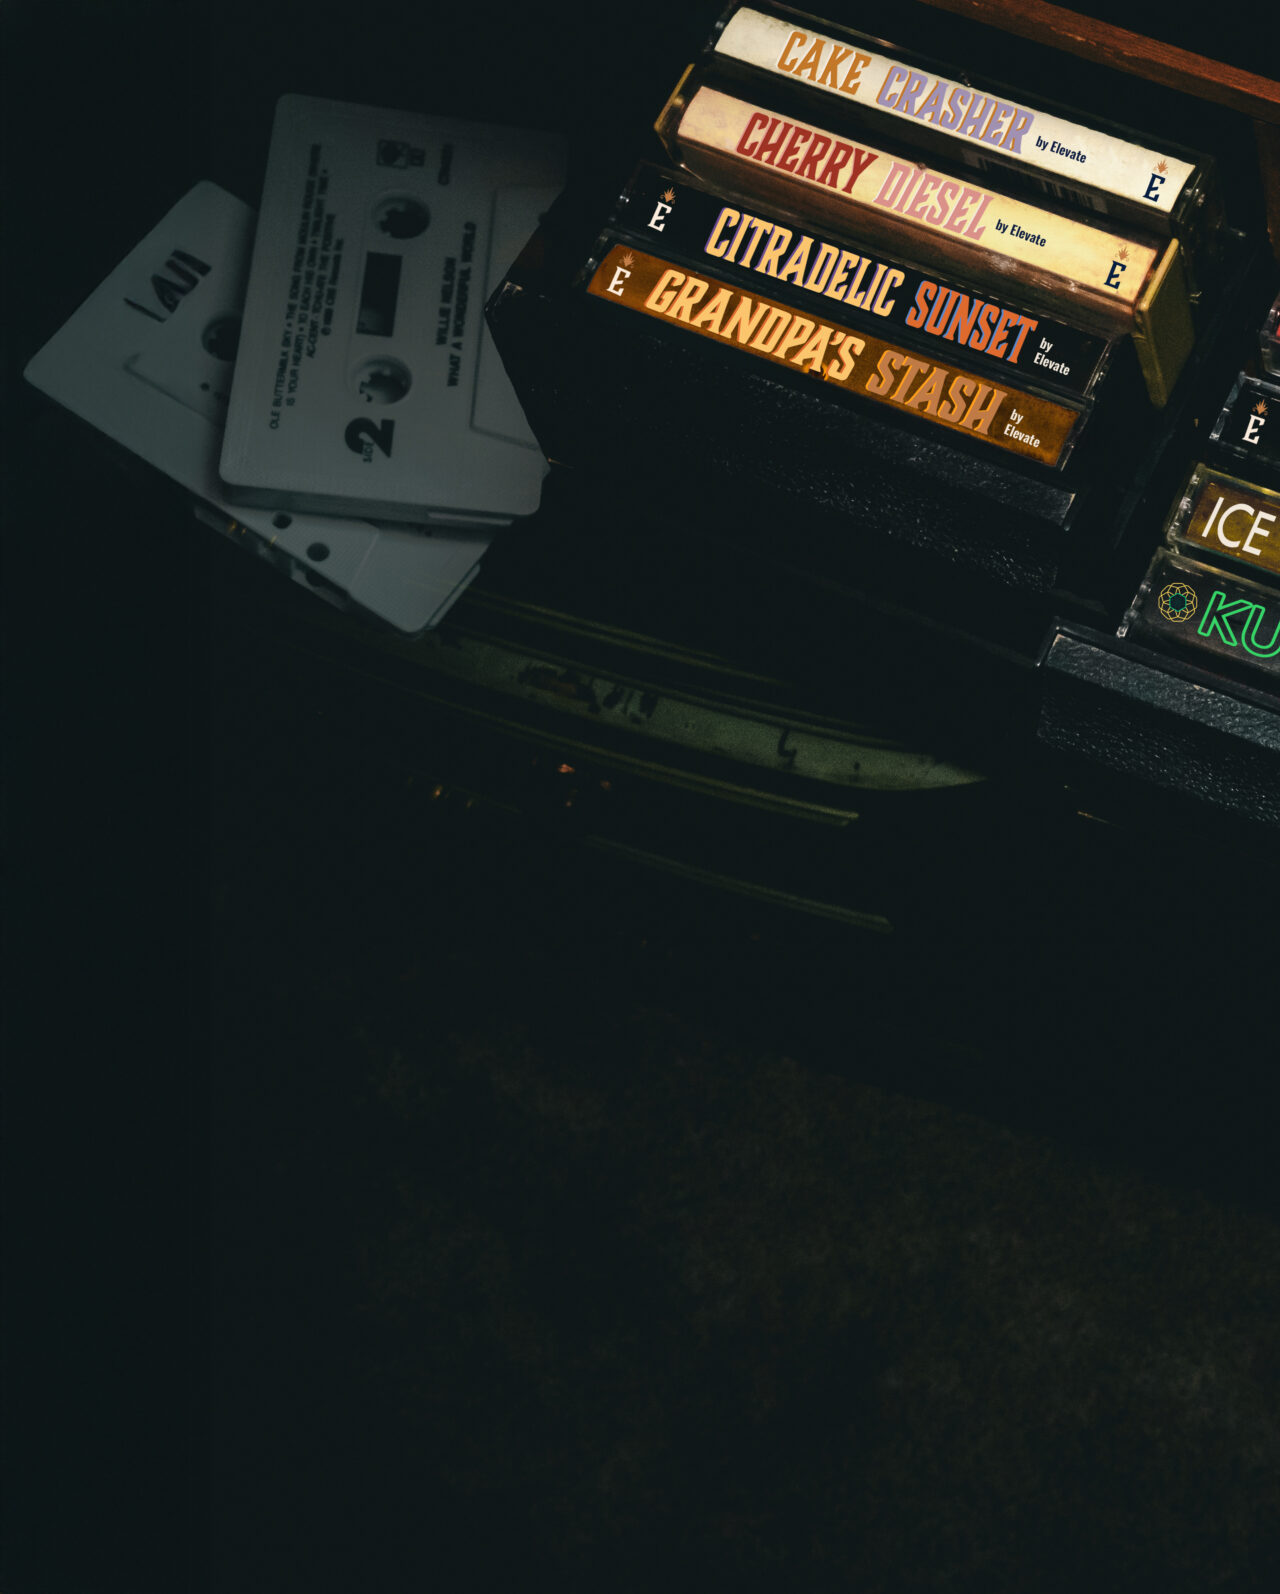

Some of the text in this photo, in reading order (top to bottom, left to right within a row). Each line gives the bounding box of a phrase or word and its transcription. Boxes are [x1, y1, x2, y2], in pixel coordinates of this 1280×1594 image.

[778, 30, 1087, 164] CAKE CRASHER by Elevate
[736, 112, 1047, 248] CHERRY DIESEL by Elevate
[1142, 172, 1166, 202] E
[648, 201, 673, 232] E
[462, 222, 476, 262] WORLD
[606, 266, 631, 296] E
[705, 207, 1038, 366] CITRADELIC SUNSET
[1104, 260, 1127, 290] E
[436, 257, 456, 345] WILLIE NELSON
[453, 268, 471, 337] WONDERFUL
[645, 268, 1008, 437] GRANDPA'S STASH
[1039, 337, 1054, 353] by
[447, 354, 460, 386] WHAT
[1033, 350, 1071, 377] Elevate
[1010, 408, 1024, 425] by
[1242, 414, 1265, 445] E
[344, 417, 395, 458] 2
[1003, 421, 1041, 448] Elevate
[1202, 496, 1276, 556] ICE
